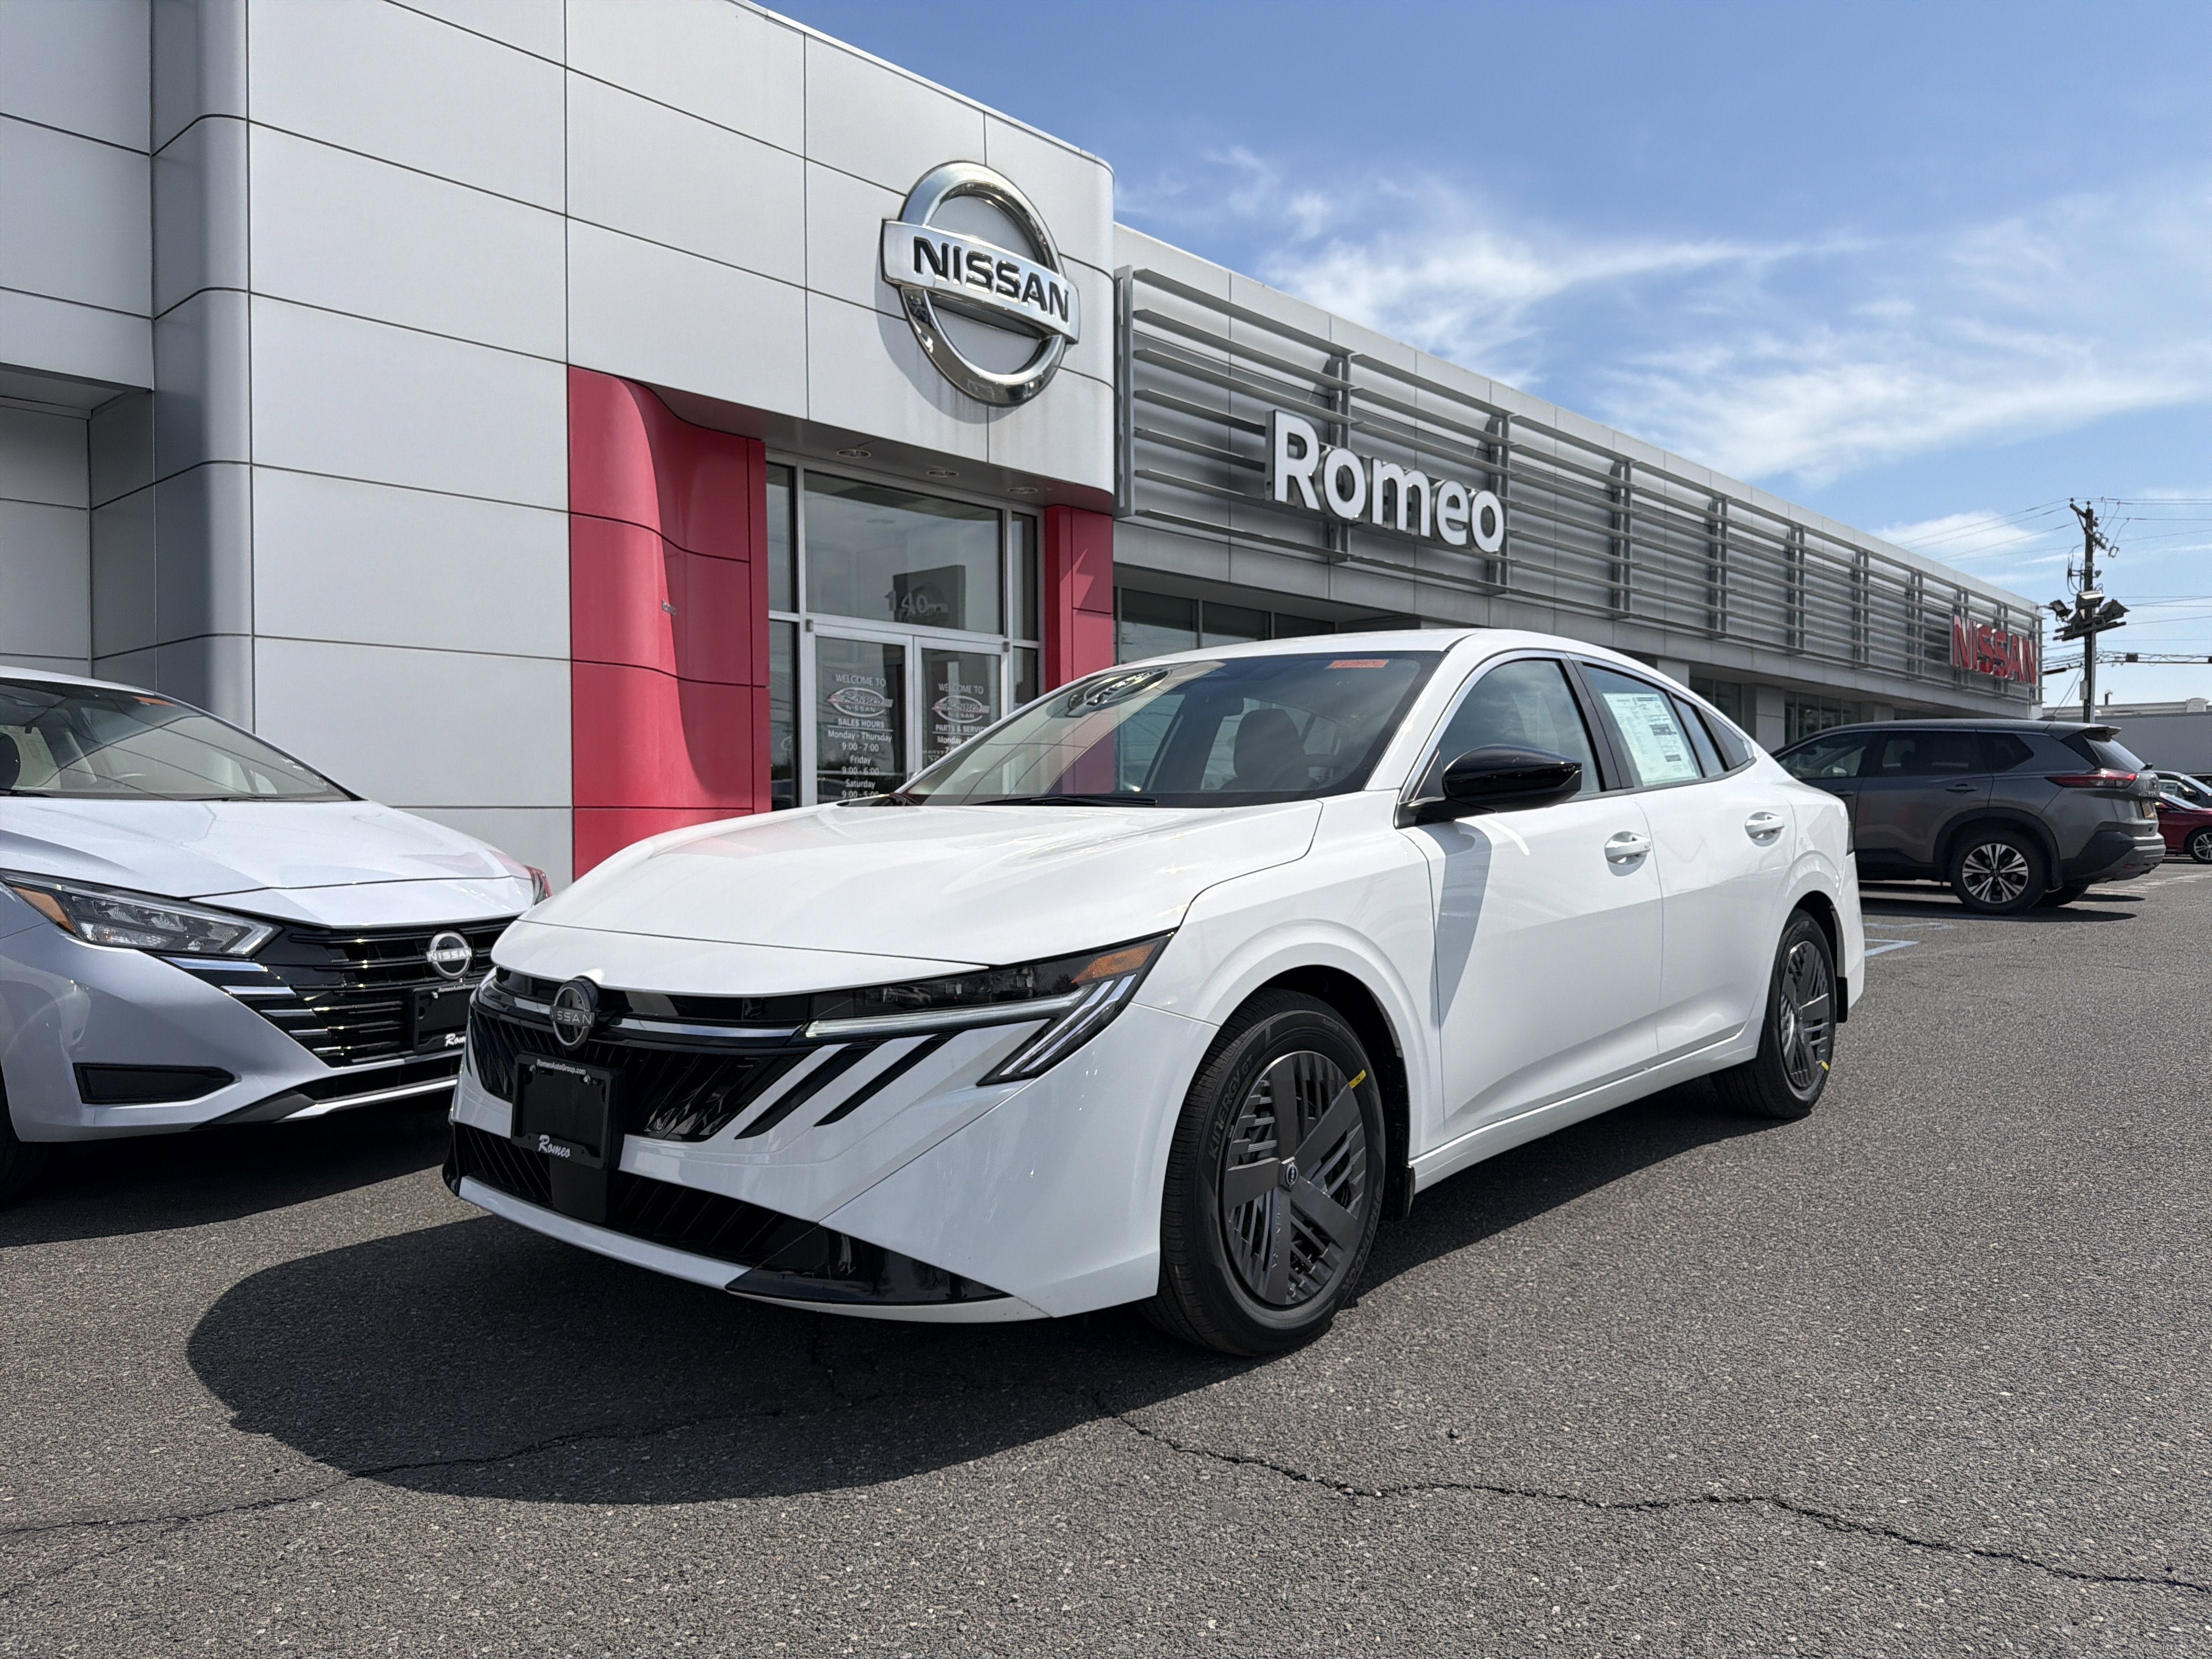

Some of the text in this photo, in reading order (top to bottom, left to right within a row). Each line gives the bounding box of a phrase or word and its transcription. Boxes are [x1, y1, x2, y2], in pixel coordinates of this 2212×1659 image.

[913, 235, 1071, 326] NISSAN
[1269, 409, 1504, 553] Romeo
[1952, 614, 2036, 685] NISSAN
[835, 674, 887, 687] WELCOME TO
[938, 683, 984, 695] WELCOME TO
[845, 704, 876, 713] NISSAN
[838, 718, 885, 729] SALES HOURS
[935, 724, 956, 732] PARTS
[828, 729, 856, 741] Monday
[861, 731, 893, 743] Thursday
[937, 736, 962, 745] Monday
[842, 742, 858, 751] 9:00
[864, 743, 879, 752] 7:00
[850, 755, 871, 766] Friday
[842, 765, 858, 775] 9:00
[863, 767, 879, 776] 6:00
[845, 778, 876, 790] Saturday
[842, 789, 858, 799] 9:00
[427, 949, 472, 962] NISSAN
[551, 1010, 592, 1024] SSAN
[444, 1032, 467, 1047] Rom
[537, 1058, 586, 1075] RomeoAutoGroup.com
[538, 1134, 571, 1158] Romeo
